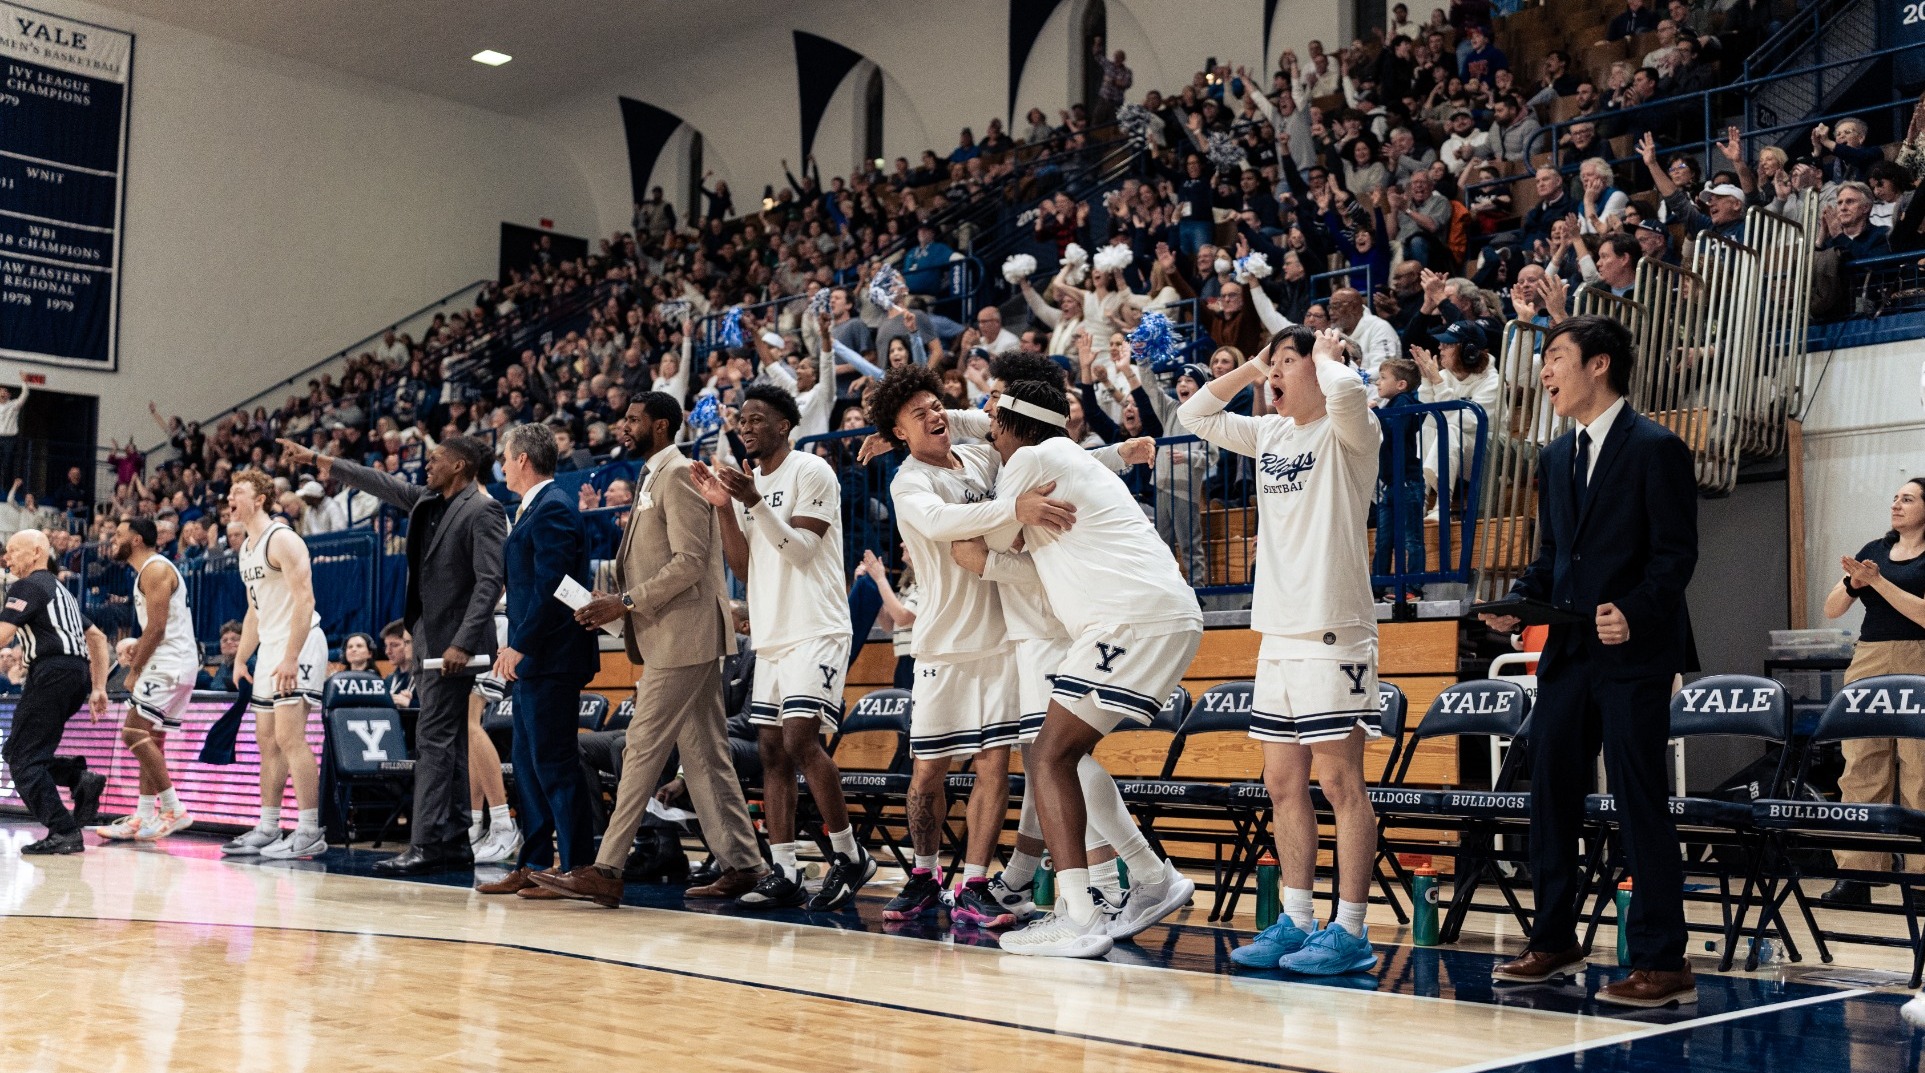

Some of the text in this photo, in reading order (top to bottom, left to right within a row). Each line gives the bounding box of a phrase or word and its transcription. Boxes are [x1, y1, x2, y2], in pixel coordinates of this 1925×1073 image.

[16, 16, 88, 51] YALE
[9, 64, 91, 93] IVY LEAGUE
[6, 77, 91, 106] CHAMPIONS
[26, 166, 64, 184] WNIT
[28, 225, 56, 240] WBI
[17, 236, 101, 260] CHAMPIONS
[3, 274, 75, 296] REGIONAL
[29, 265, 92, 285] EASTERN
[2, 291, 75, 312] 1978 1979
[1095, 641, 1127, 673] Y
[299, 664, 312, 680] Y
[819, 664, 837, 690] Y
[1340, 663, 1369, 695] Y
[143, 681, 160, 697] Y
[333, 679, 386, 695] YALE
[496, 700, 513, 716] YA
[578, 700, 600, 716] LE
[857, 698, 910, 716] YALE
[1203, 692, 1252, 713] YAL
[1440, 691, 1516, 714] YALE
[1681, 688, 1776, 713] YALE
[1842, 688, 1925, 714] YAL
[347, 719, 392, 761] Y
[841, 776, 887, 786] BULLDOGS
[1123, 783, 1187, 796] BULLDOGS
[1451, 794, 1525, 809] BULLDOGS
[1769, 804, 1869, 822] BULLDOGS
